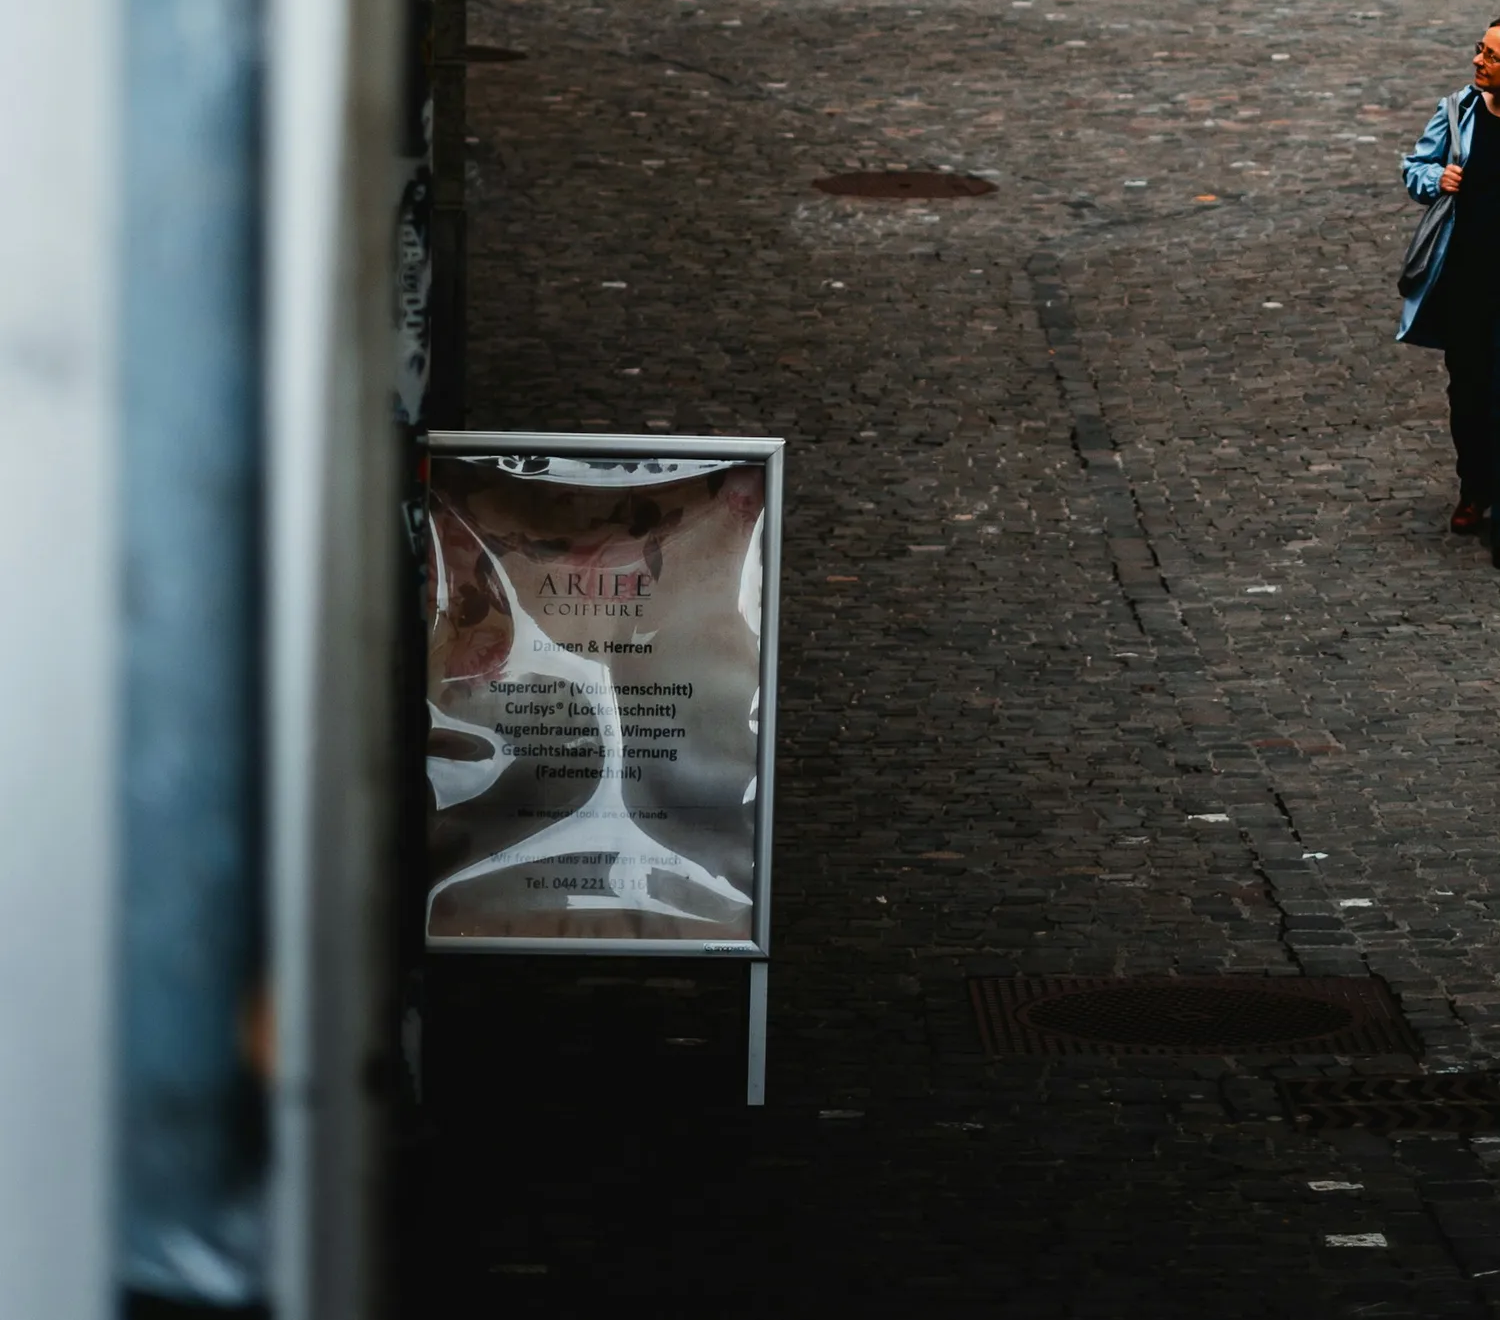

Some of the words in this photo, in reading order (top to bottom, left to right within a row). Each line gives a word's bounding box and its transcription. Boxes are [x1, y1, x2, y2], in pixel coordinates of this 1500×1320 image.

[538, 573, 651, 597] ARIFE
[543, 603, 644, 617] COIFFURE
[533, 639, 584, 653] Damen
[587, 640, 599, 654] &
[603, 641, 653, 654] Herren
[494, 722, 600, 739] Augenbraunen
[603, 724, 615, 737] &
[621, 724, 686, 741] Wimpern
[535, 765, 643, 782] (Fadentechnik)
[536, 809, 573, 821] magical
[602, 811, 619, 819] are
[638, 809, 668, 820] hands
[557, 855, 580, 865] uns
[582, 852, 602, 865] auf
[639, 853, 682, 865] Besuch
[524, 876, 549, 890] Tel.
[552, 877, 577, 890] 044
[580, 877, 605, 890] 221
